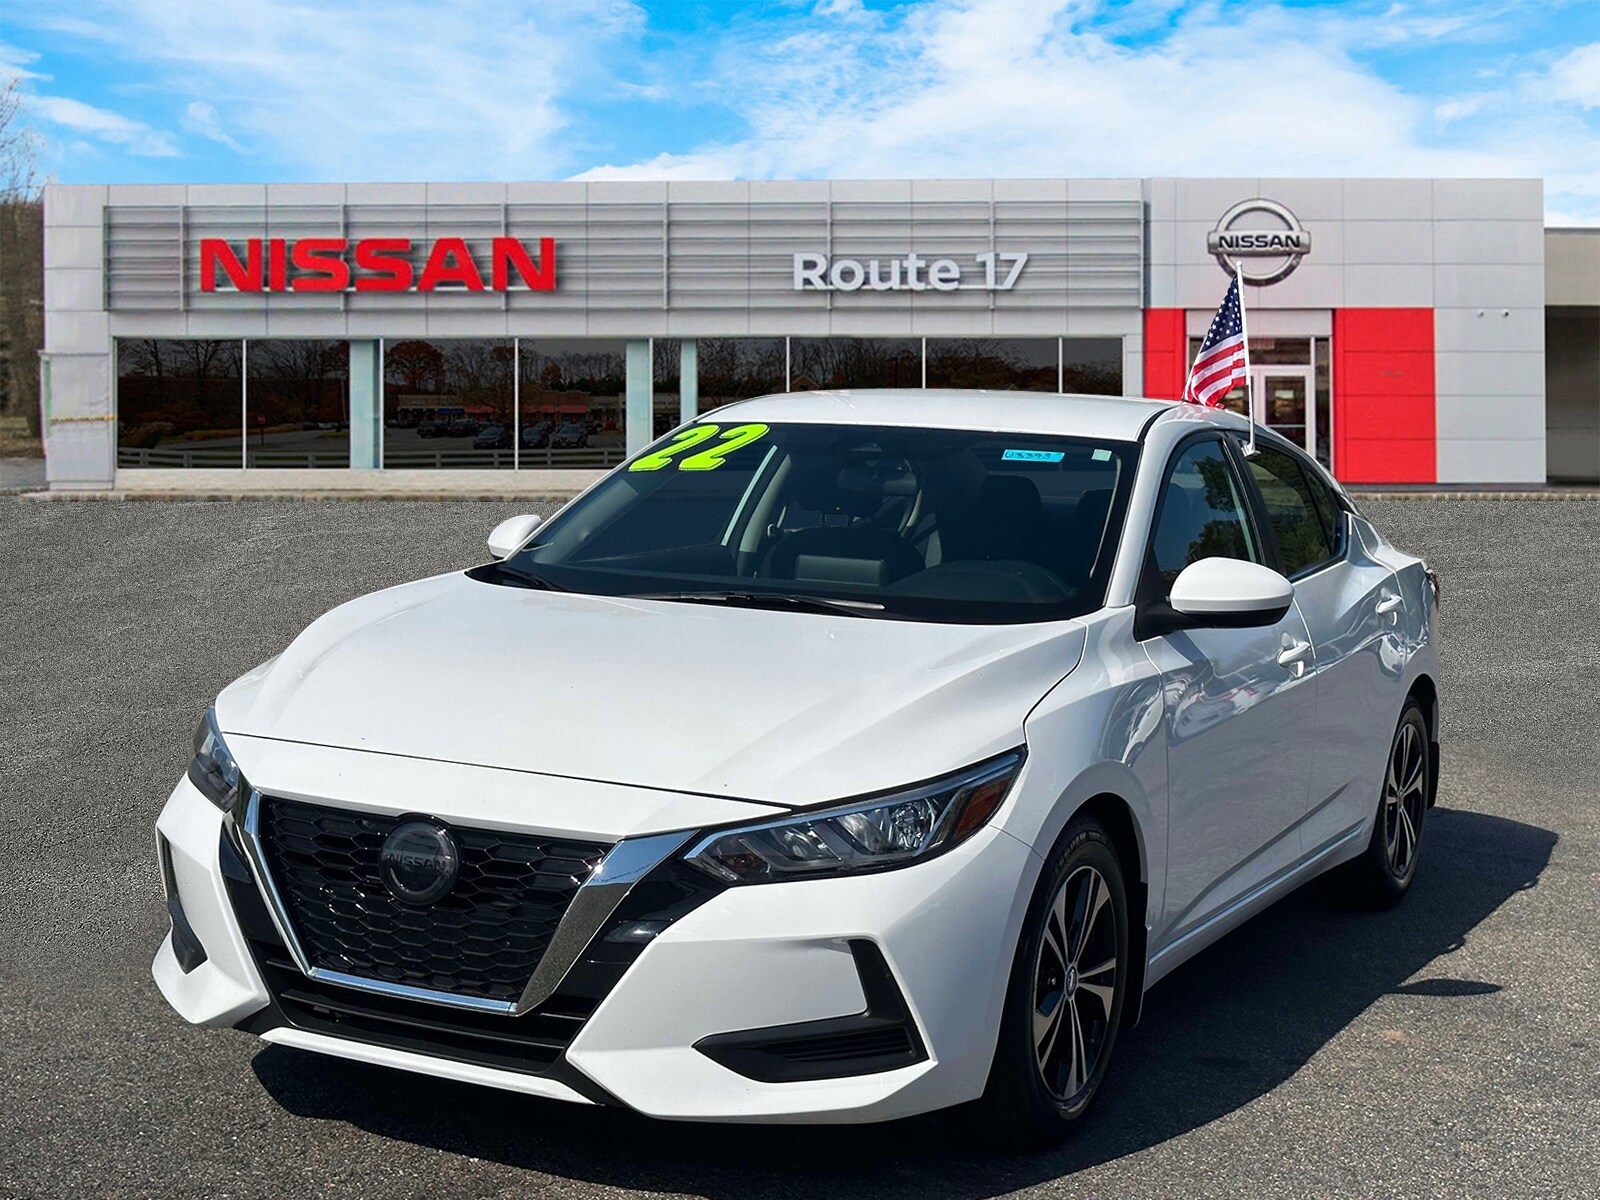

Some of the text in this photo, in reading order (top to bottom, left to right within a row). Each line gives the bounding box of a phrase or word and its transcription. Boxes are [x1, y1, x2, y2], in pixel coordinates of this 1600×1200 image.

[1219, 235, 1300, 248] NISSAN
[200, 237, 555, 292] NISSAN
[793, 252, 1028, 290] Route 17
[628, 423, 770, 471] 22
[389, 852, 448, 871] NISSAN
